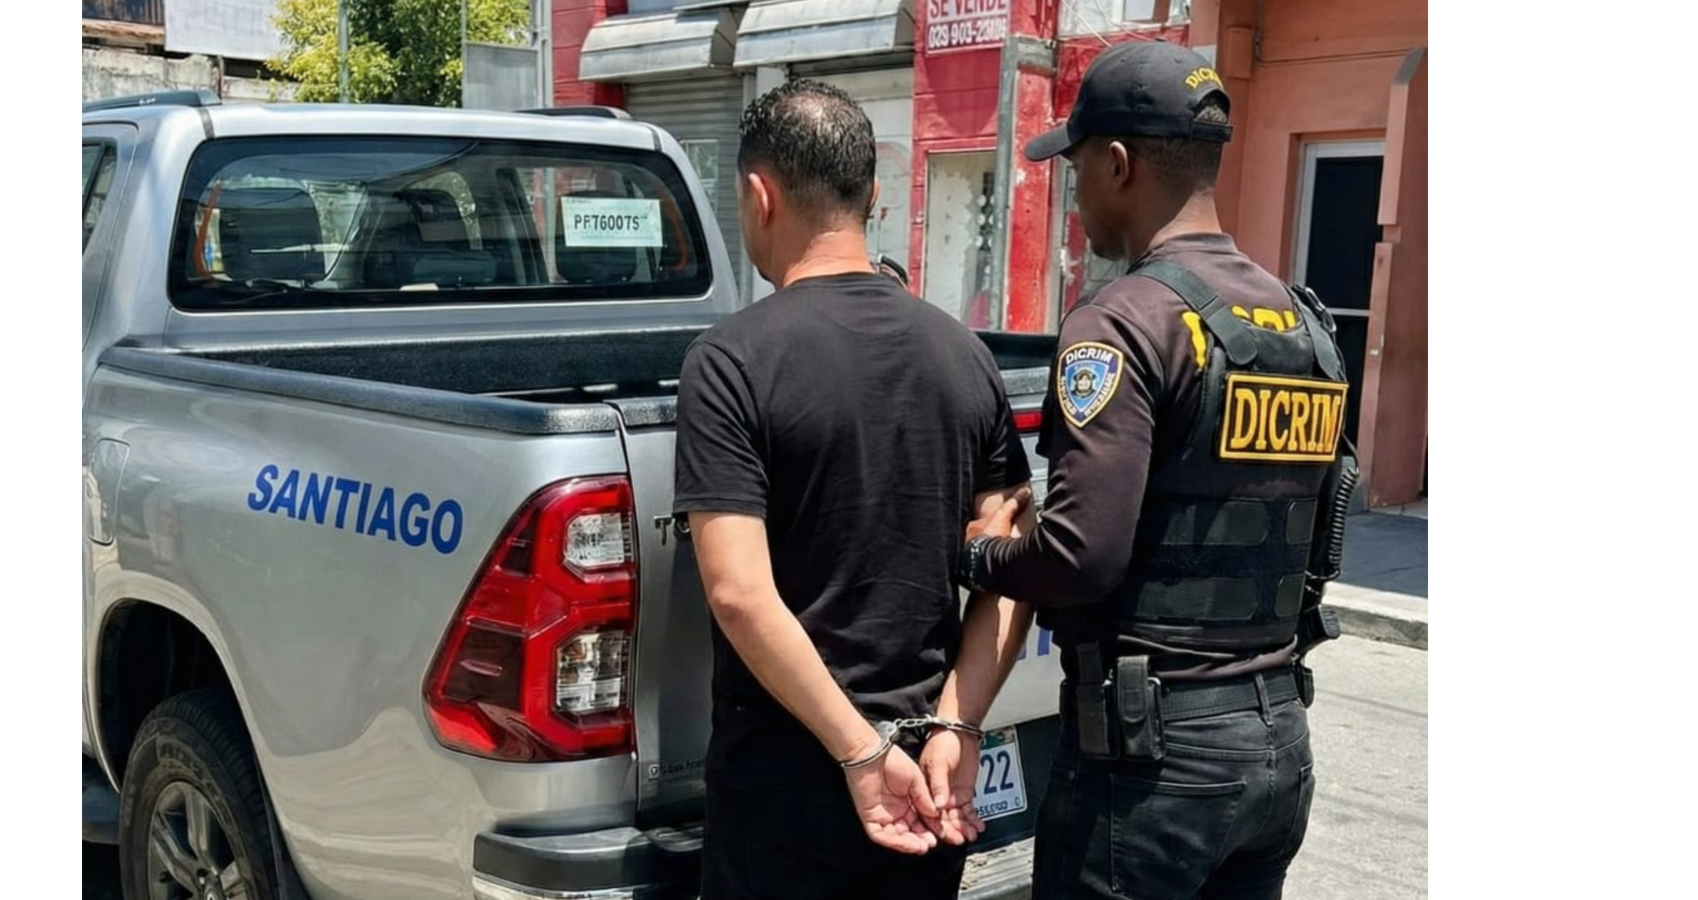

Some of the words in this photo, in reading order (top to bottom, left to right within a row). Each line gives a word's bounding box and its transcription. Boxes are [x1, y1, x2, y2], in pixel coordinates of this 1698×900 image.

[930, 0, 948, 18] SE
[956, 0, 1006, 15] VENDE
[1066, 348, 1114, 365] DICRIM
[1230, 388, 1341, 453] DICRIM
[248, 464, 463, 554] SANTIAGO
[974, 750, 1014, 798] 22
